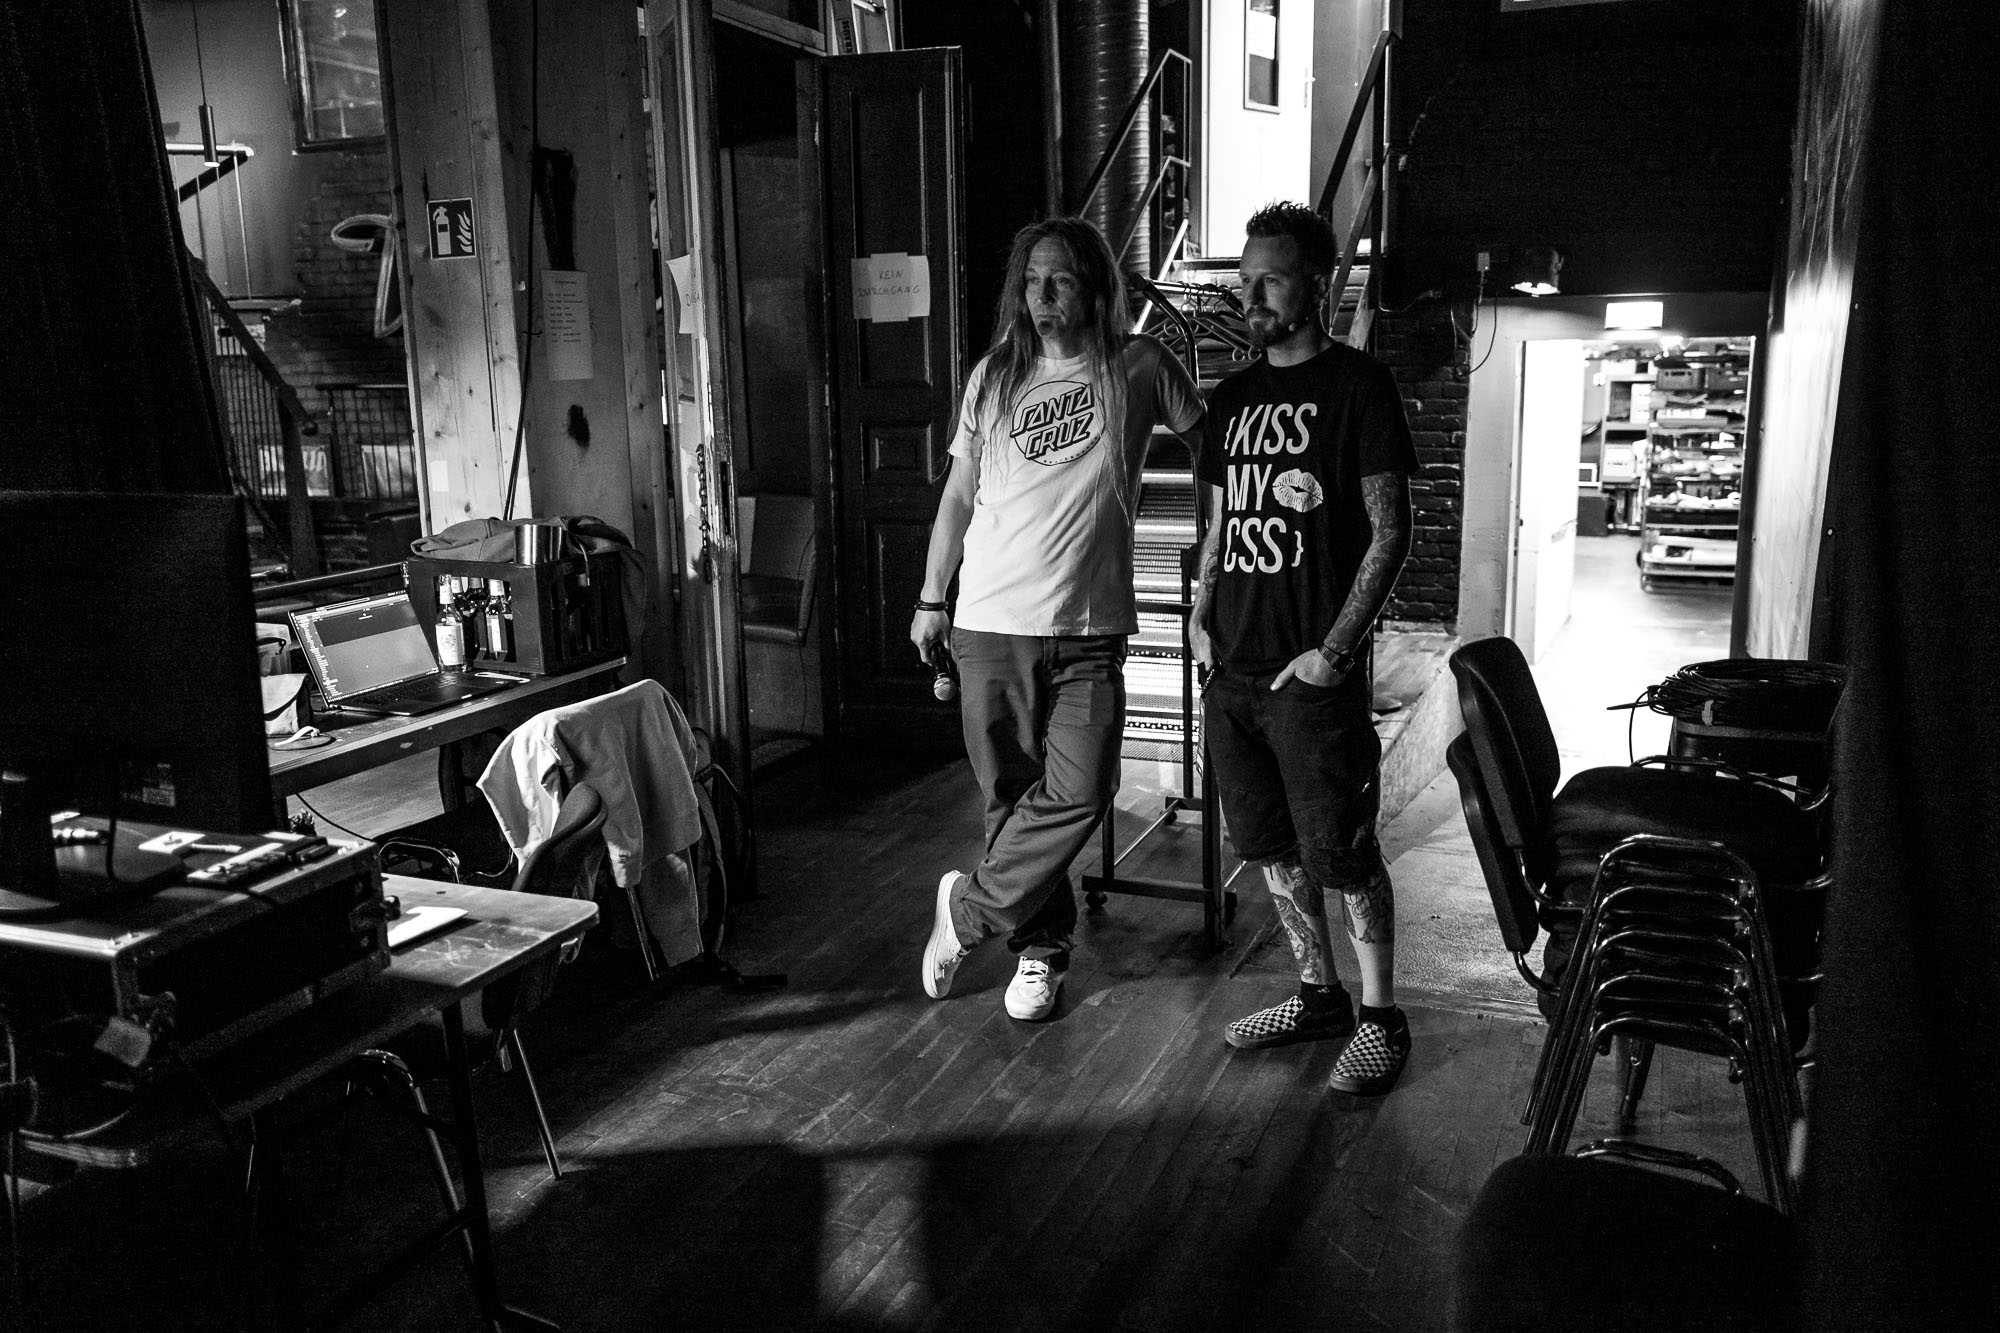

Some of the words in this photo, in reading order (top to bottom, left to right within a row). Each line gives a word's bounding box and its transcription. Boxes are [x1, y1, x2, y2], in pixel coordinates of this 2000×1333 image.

[857, 284, 920, 298] DURCHGANG
[879, 269, 904, 280] KEIN
[1010, 382, 1095, 438] SANTA
[1025, 411, 1095, 460] CRUZ
[1227, 463, 1273, 511] MY
